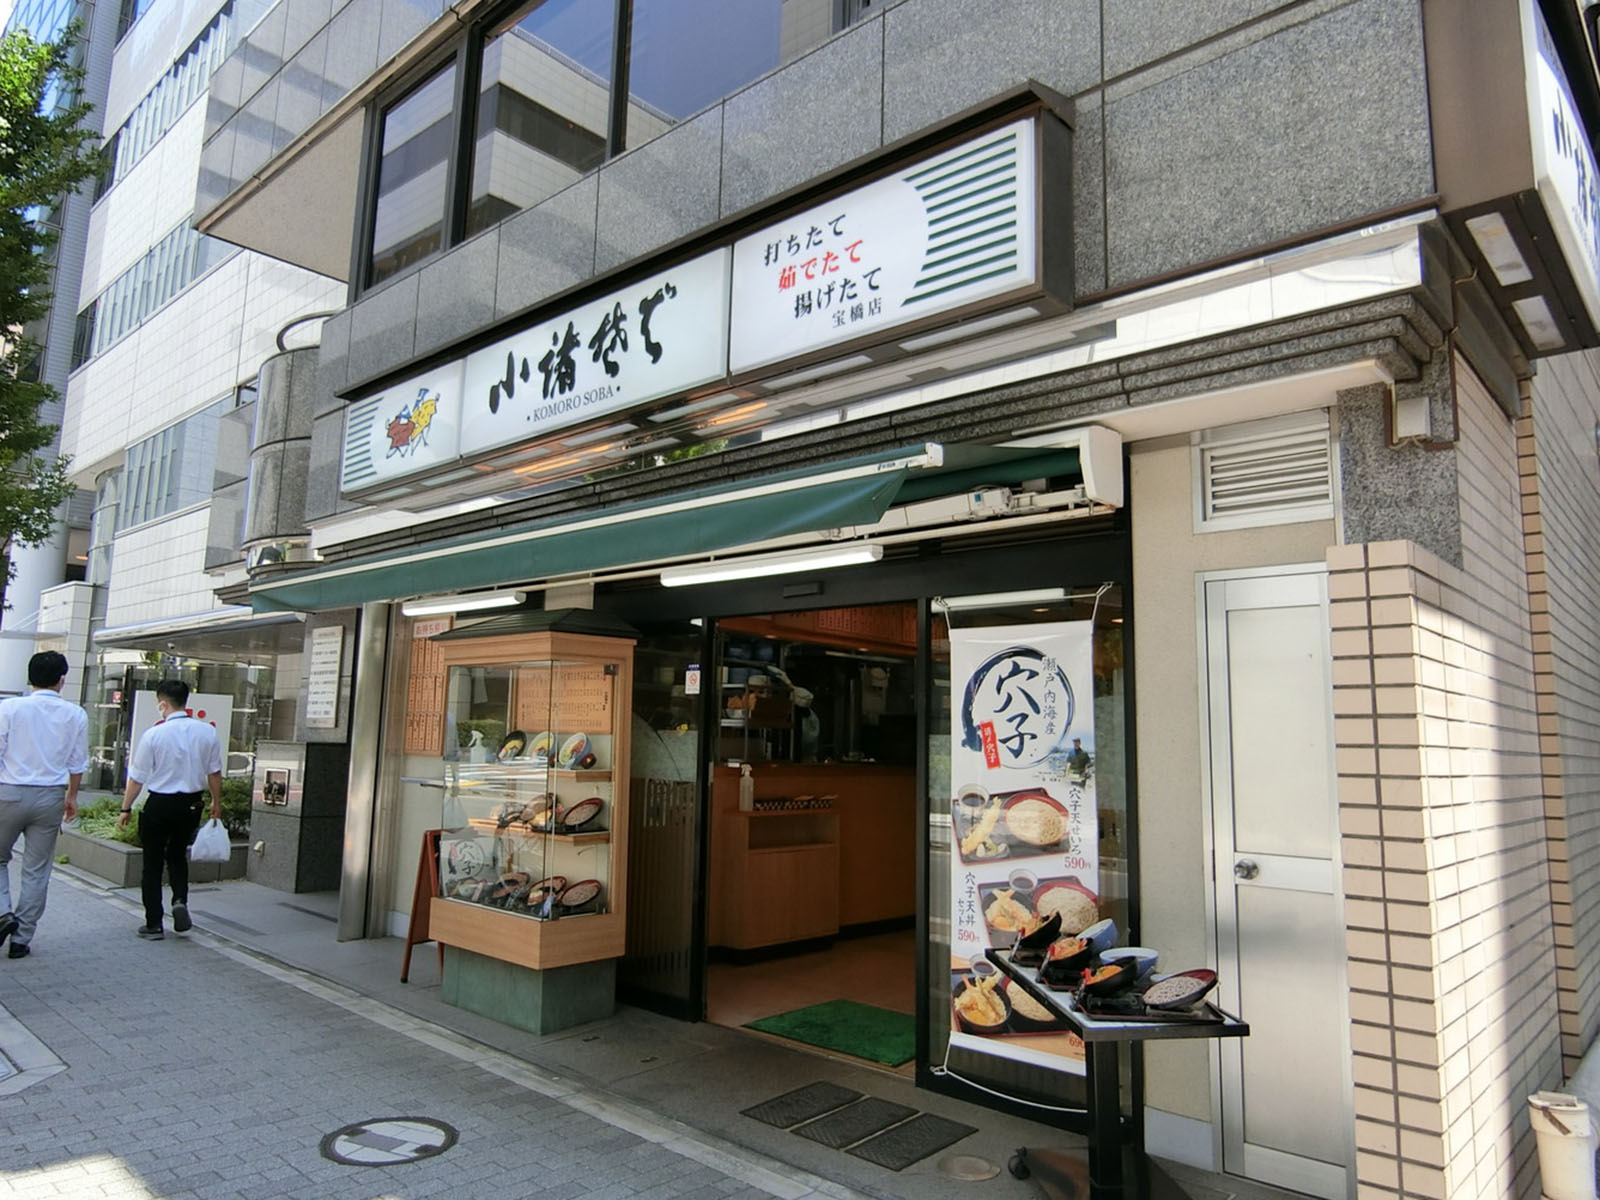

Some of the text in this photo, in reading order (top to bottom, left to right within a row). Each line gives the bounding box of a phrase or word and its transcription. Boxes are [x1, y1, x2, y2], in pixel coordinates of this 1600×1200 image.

[764, 214, 846, 266] 打ちたて
[778, 240, 863, 293] 茹でたて
[794, 267, 882, 319] 揚げたて
[533, 385, 614, 422] KOMORO SOBA
[993, 660, 1041, 759] 穴子
[1043, 657, 1058, 735] 瀬戸内海産
[1069, 787, 1082, 855] 穴子天せいろ
